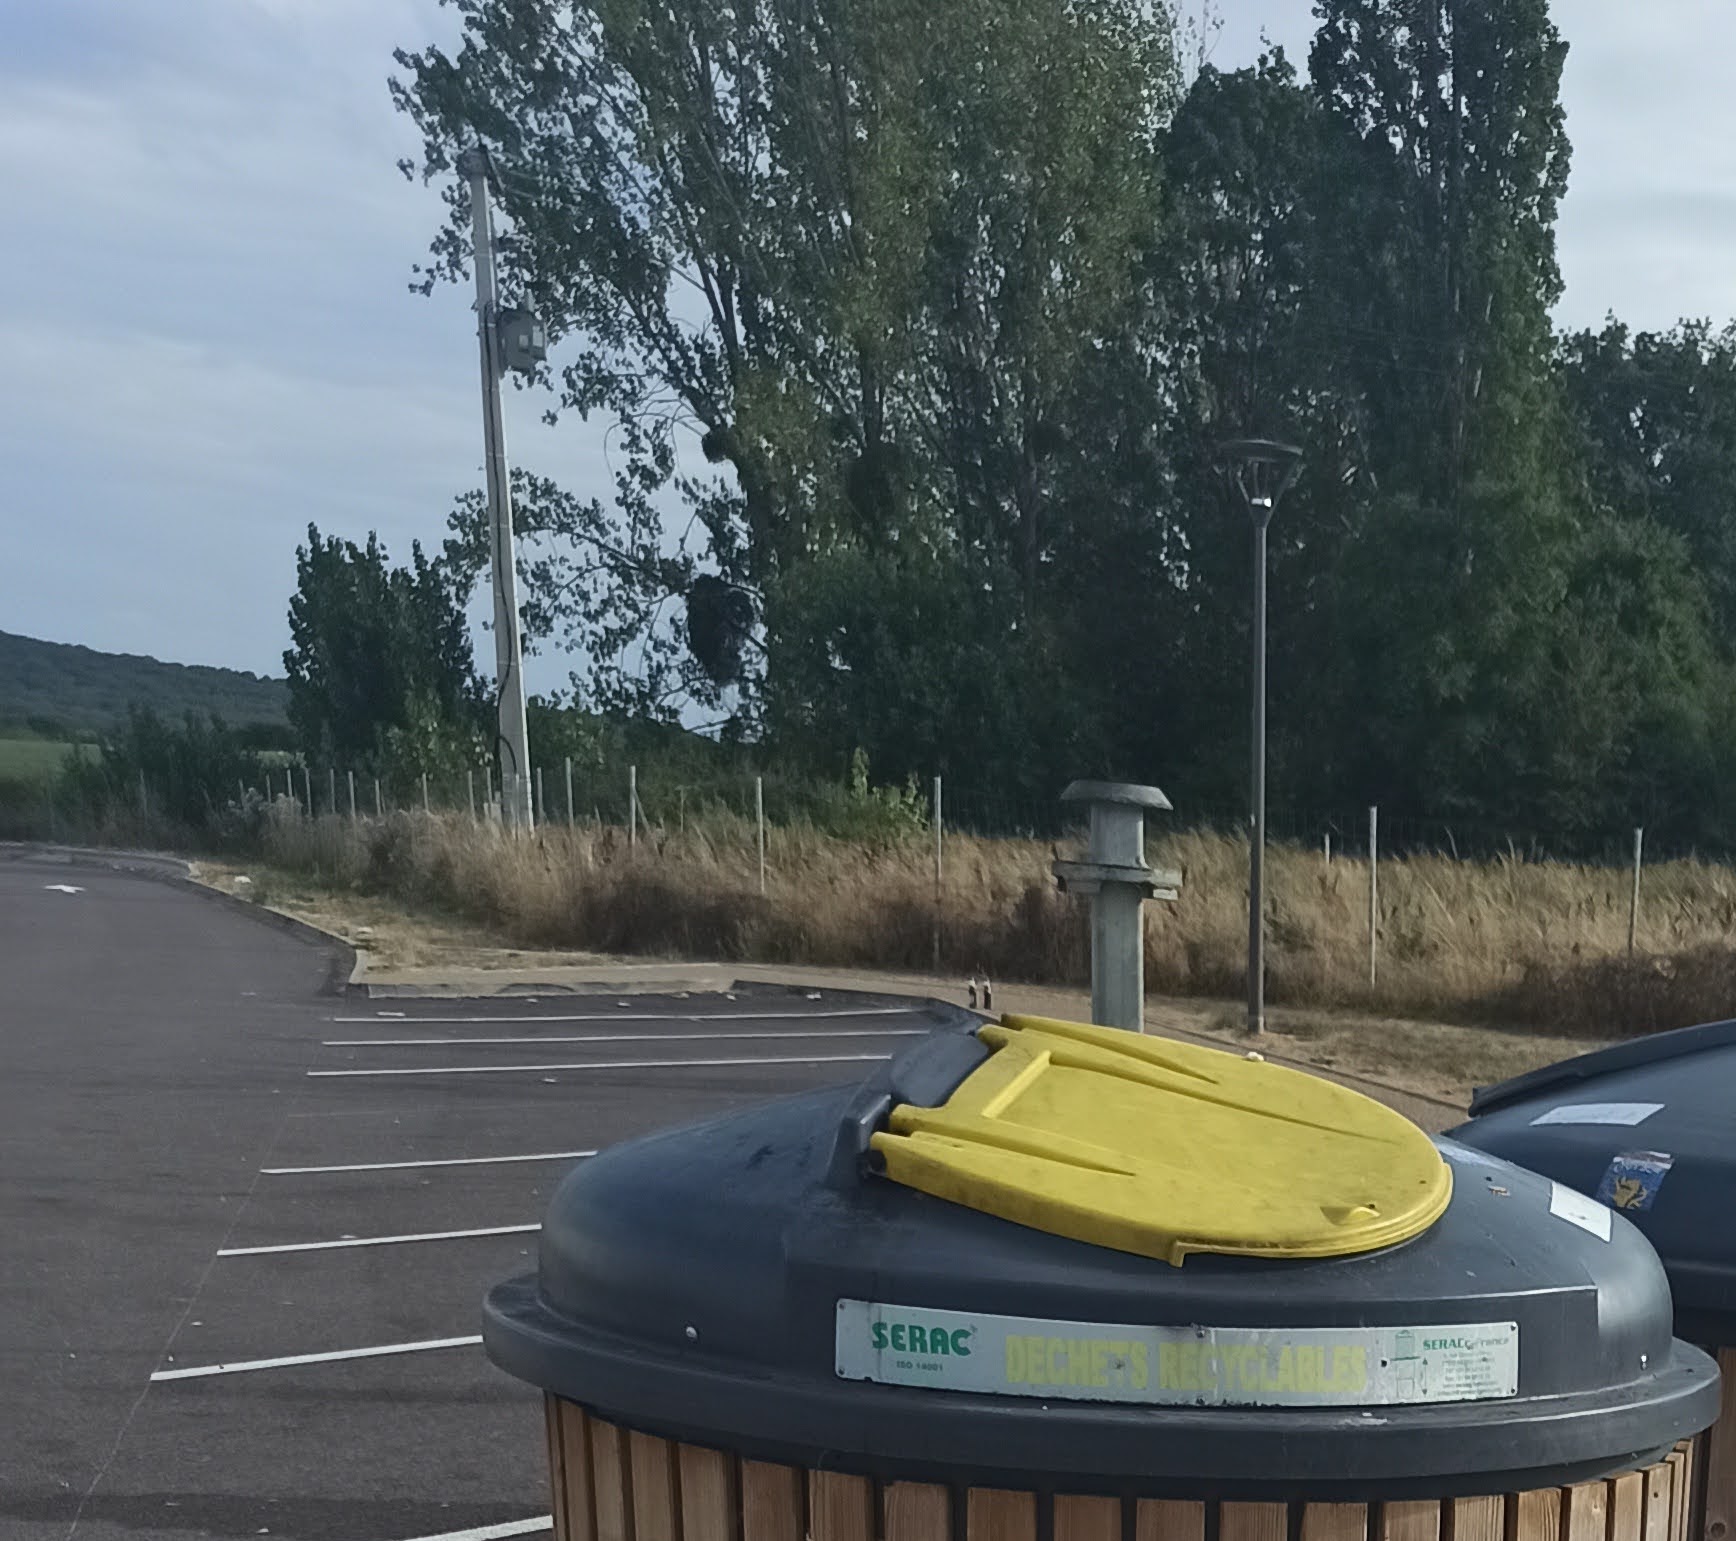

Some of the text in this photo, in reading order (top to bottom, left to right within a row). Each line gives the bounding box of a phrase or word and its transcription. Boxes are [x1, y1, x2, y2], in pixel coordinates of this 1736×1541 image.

[872, 1322, 974, 1356] SERAC
[1006, 1334, 1367, 1393] DECHETS RECYCLABLES
